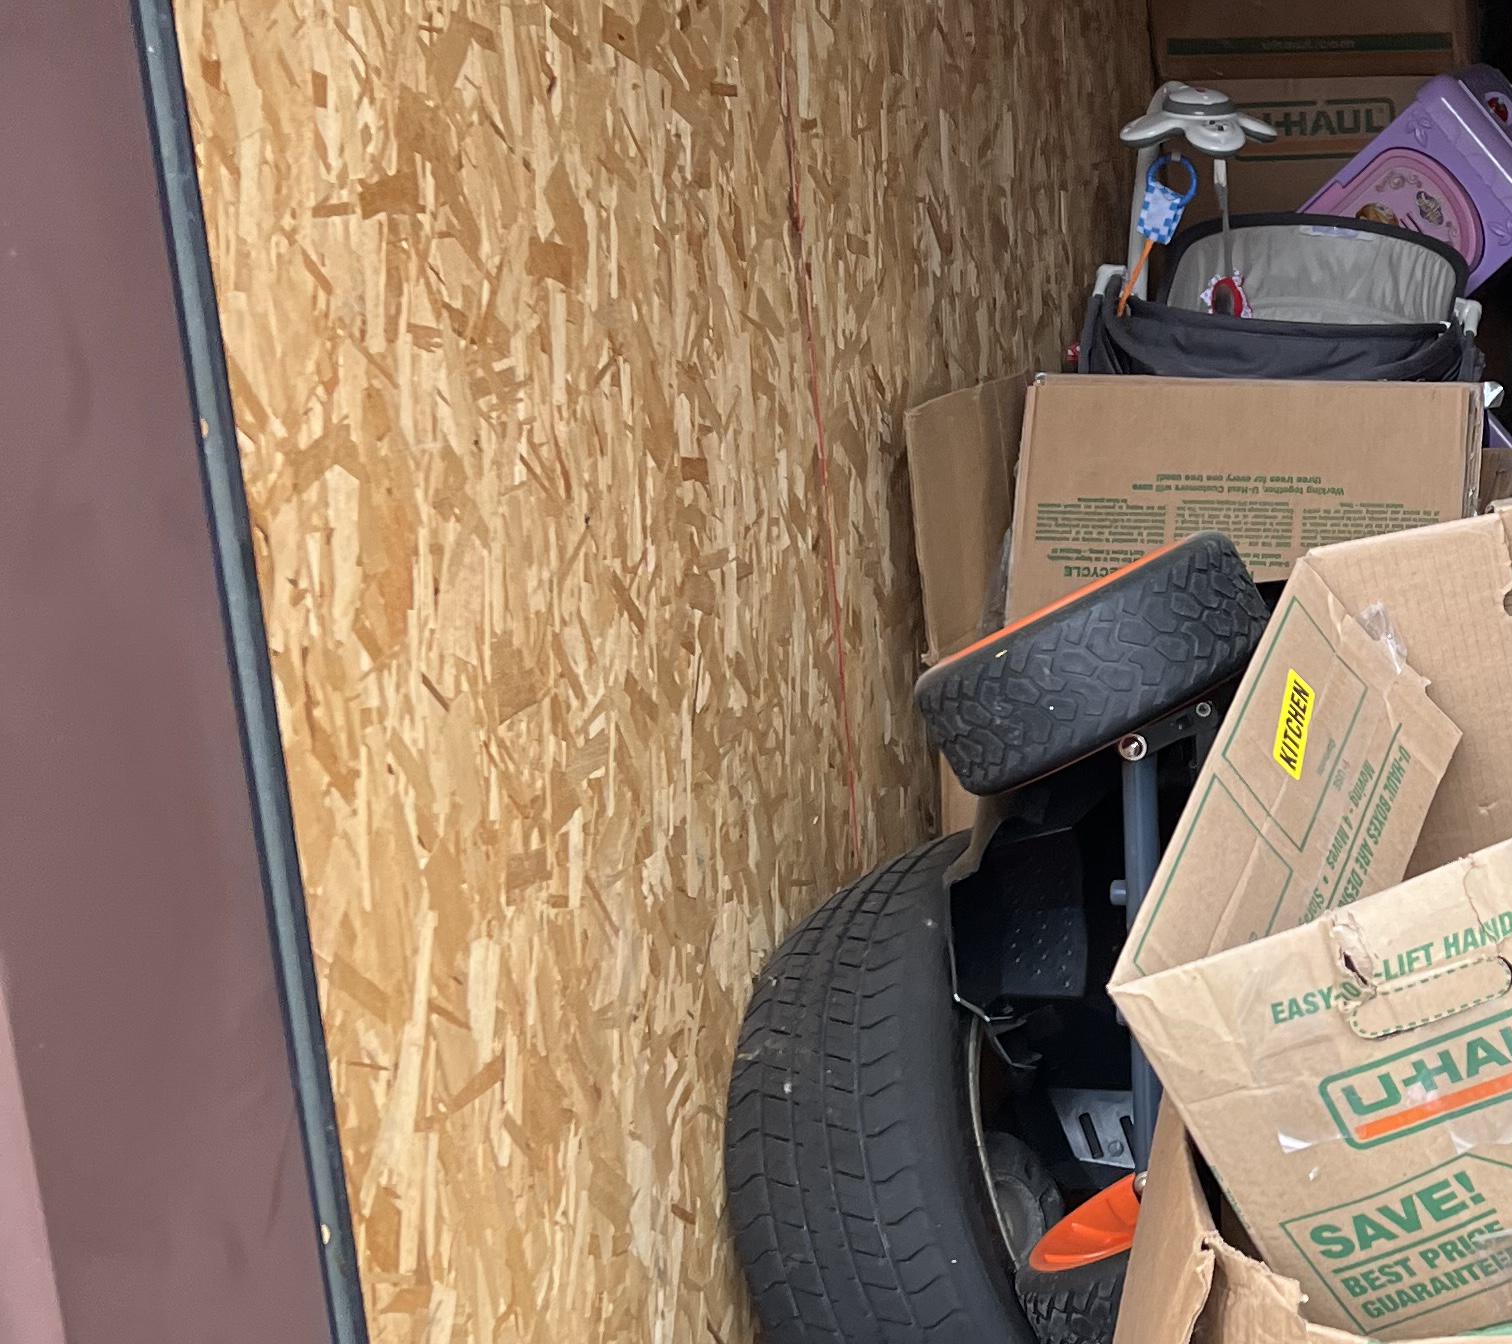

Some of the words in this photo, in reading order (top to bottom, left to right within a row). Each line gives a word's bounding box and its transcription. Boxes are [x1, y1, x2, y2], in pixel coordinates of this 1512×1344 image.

[1264, 109, 1385, 137] -HAUL
[1306, 486, 1345, 497] Working
[1279, 679, 1310, 771] KITCHEN
[1349, 759, 1376, 808] Moving
[1367, 797, 1393, 843] BOXES
[1327, 828, 1352, 871] Moves
[1354, 840, 1376, 872] ARE
[1310, 1171, 1486, 1259] SAVE!
[1341, 1258, 1417, 1298] BEST
[1419, 1220, 1504, 1269] PRICE
